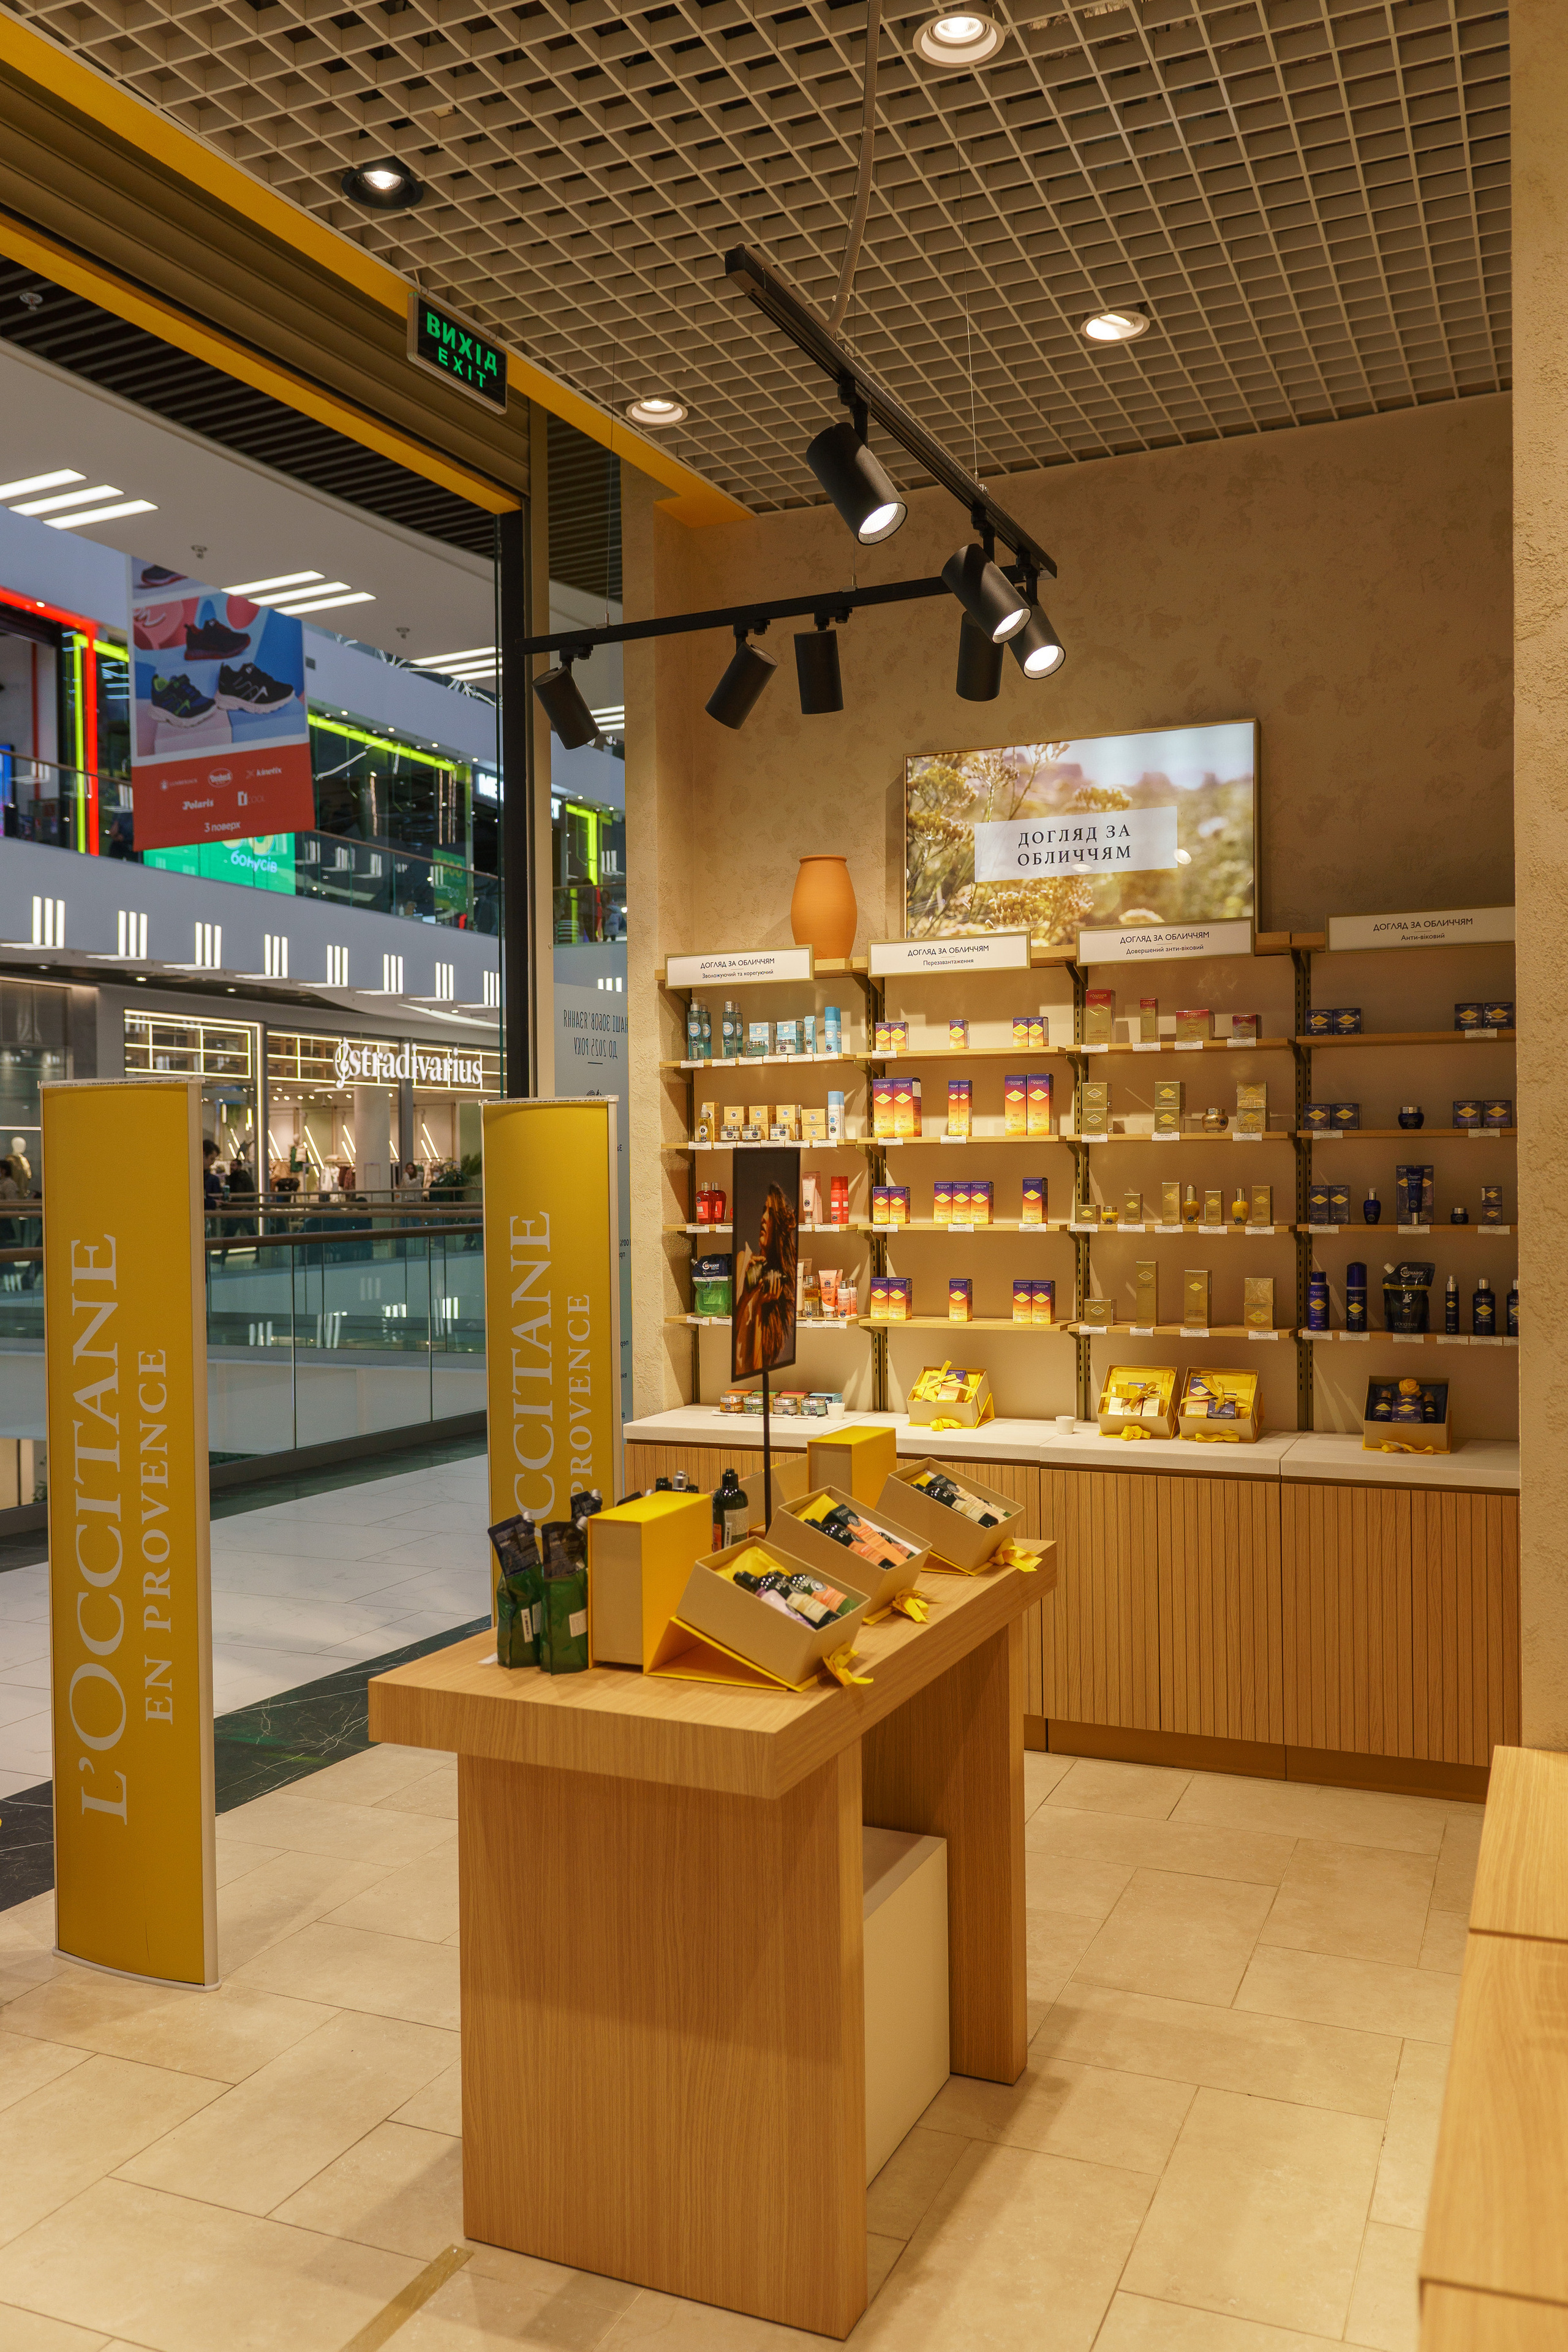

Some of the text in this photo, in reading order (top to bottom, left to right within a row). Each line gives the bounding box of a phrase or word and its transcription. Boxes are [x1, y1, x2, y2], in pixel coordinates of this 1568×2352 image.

[427, 311, 497, 377] ВИХІД
[439, 346, 486, 388] EXIT
[183, 799, 214, 810] Polaris
[204, 821, 241, 833] 3 поверх
[1018, 824, 1131, 848] ДОГЛЯД ЗА
[230, 850, 277, 873] бонусів
[1017, 845, 1131, 867] ОБЛИЧЧЯМ
[1373, 922, 1408, 932] ДОГЛЯД
[1423, 918, 1473, 928] ОБЛИЧЧЯМ
[1120, 935, 1152, 944] ДОГЛЯД
[1165, 932, 1210, 941] ОБЛИЧЧЯМ
[1401, 932, 1445, 941] Анти-віковий
[907, 948, 937, 957] ДОГЛЯД
[949, 945, 989, 954] ОБЛИЧЧЯМ
[1126, 946, 1164, 956] Довершений
[700, 961, 727, 970] ДОГЛЯД
[738, 958, 775, 967] ОБЛИЧЧЯМ
[744, 969, 774, 978] корегуючий
[349, 1042, 483, 1085] stradivarius
[69, 1233, 128, 1825] L'OCCITANE
[138, 1349, 173, 1725] EN PROVENCE
